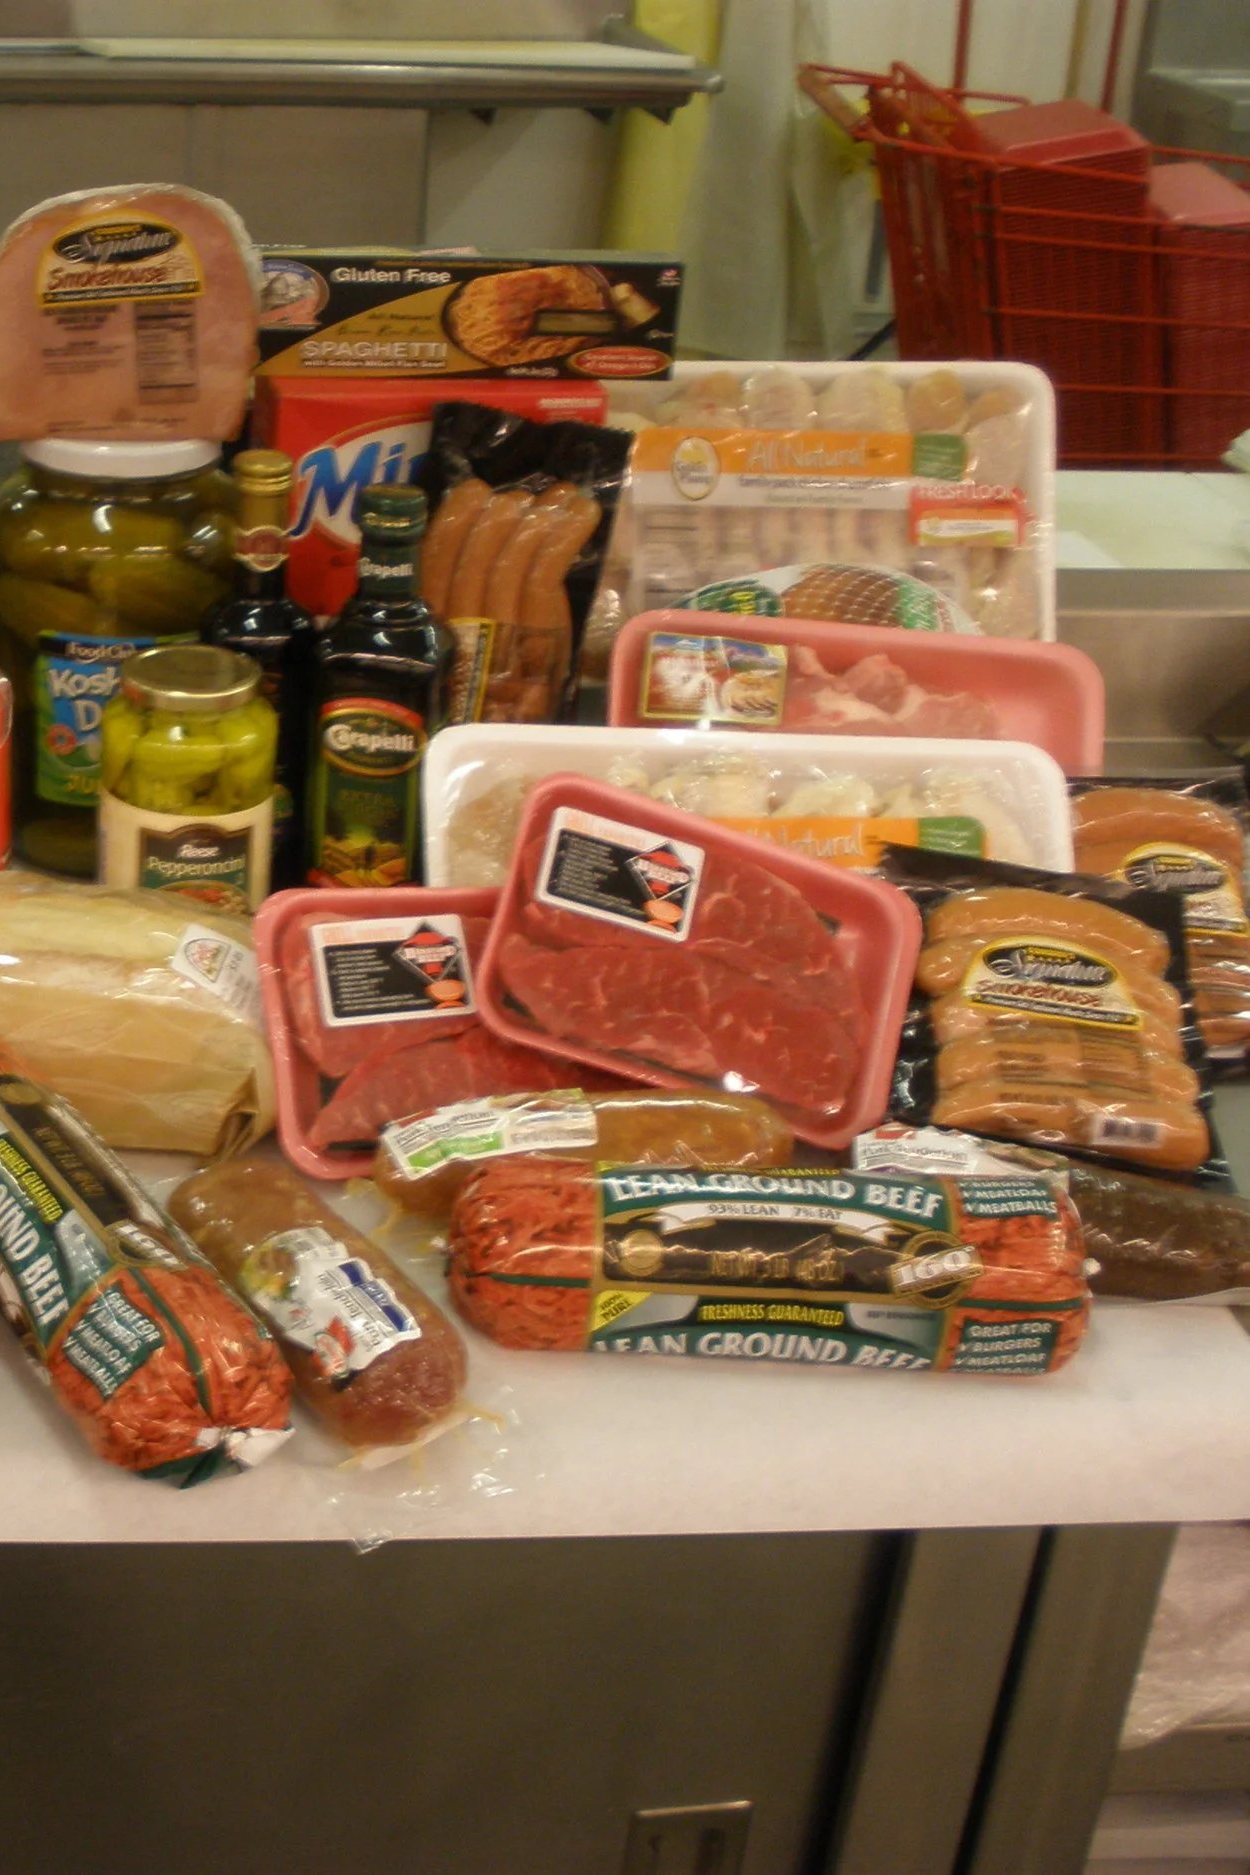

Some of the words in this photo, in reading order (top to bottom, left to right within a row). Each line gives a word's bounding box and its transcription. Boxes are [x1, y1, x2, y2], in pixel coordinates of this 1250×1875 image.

[332, 267, 400, 283] Gluten
[406, 268, 451, 284] Free
[302, 341, 447, 358] SPAGHETTI
[608, 1173, 698, 1201] LEAN
[706, 1173, 856, 1200] GROUND
[863, 1184, 943, 1218] BEEF
[708, 1205, 740, 1215] 93%
[743, 1205, 780, 1216] LEAN
[793, 1207, 815, 1218] 7%
[818, 1209, 843, 1219] FAT
[979, 1200, 1057, 1216] MEATBALLS
[17, 1251, 70, 1327] BEEF
[702, 1304, 765, 1320] FRESHNESS
[768, 1304, 844, 1326] GUARANTEED
[969, 1323, 1017, 1337] GREAT
[1022, 1322, 1051, 1334] FOR
[697, 1331, 847, 1363] GROUND
[973, 1337, 1042, 1352] BURGERS
